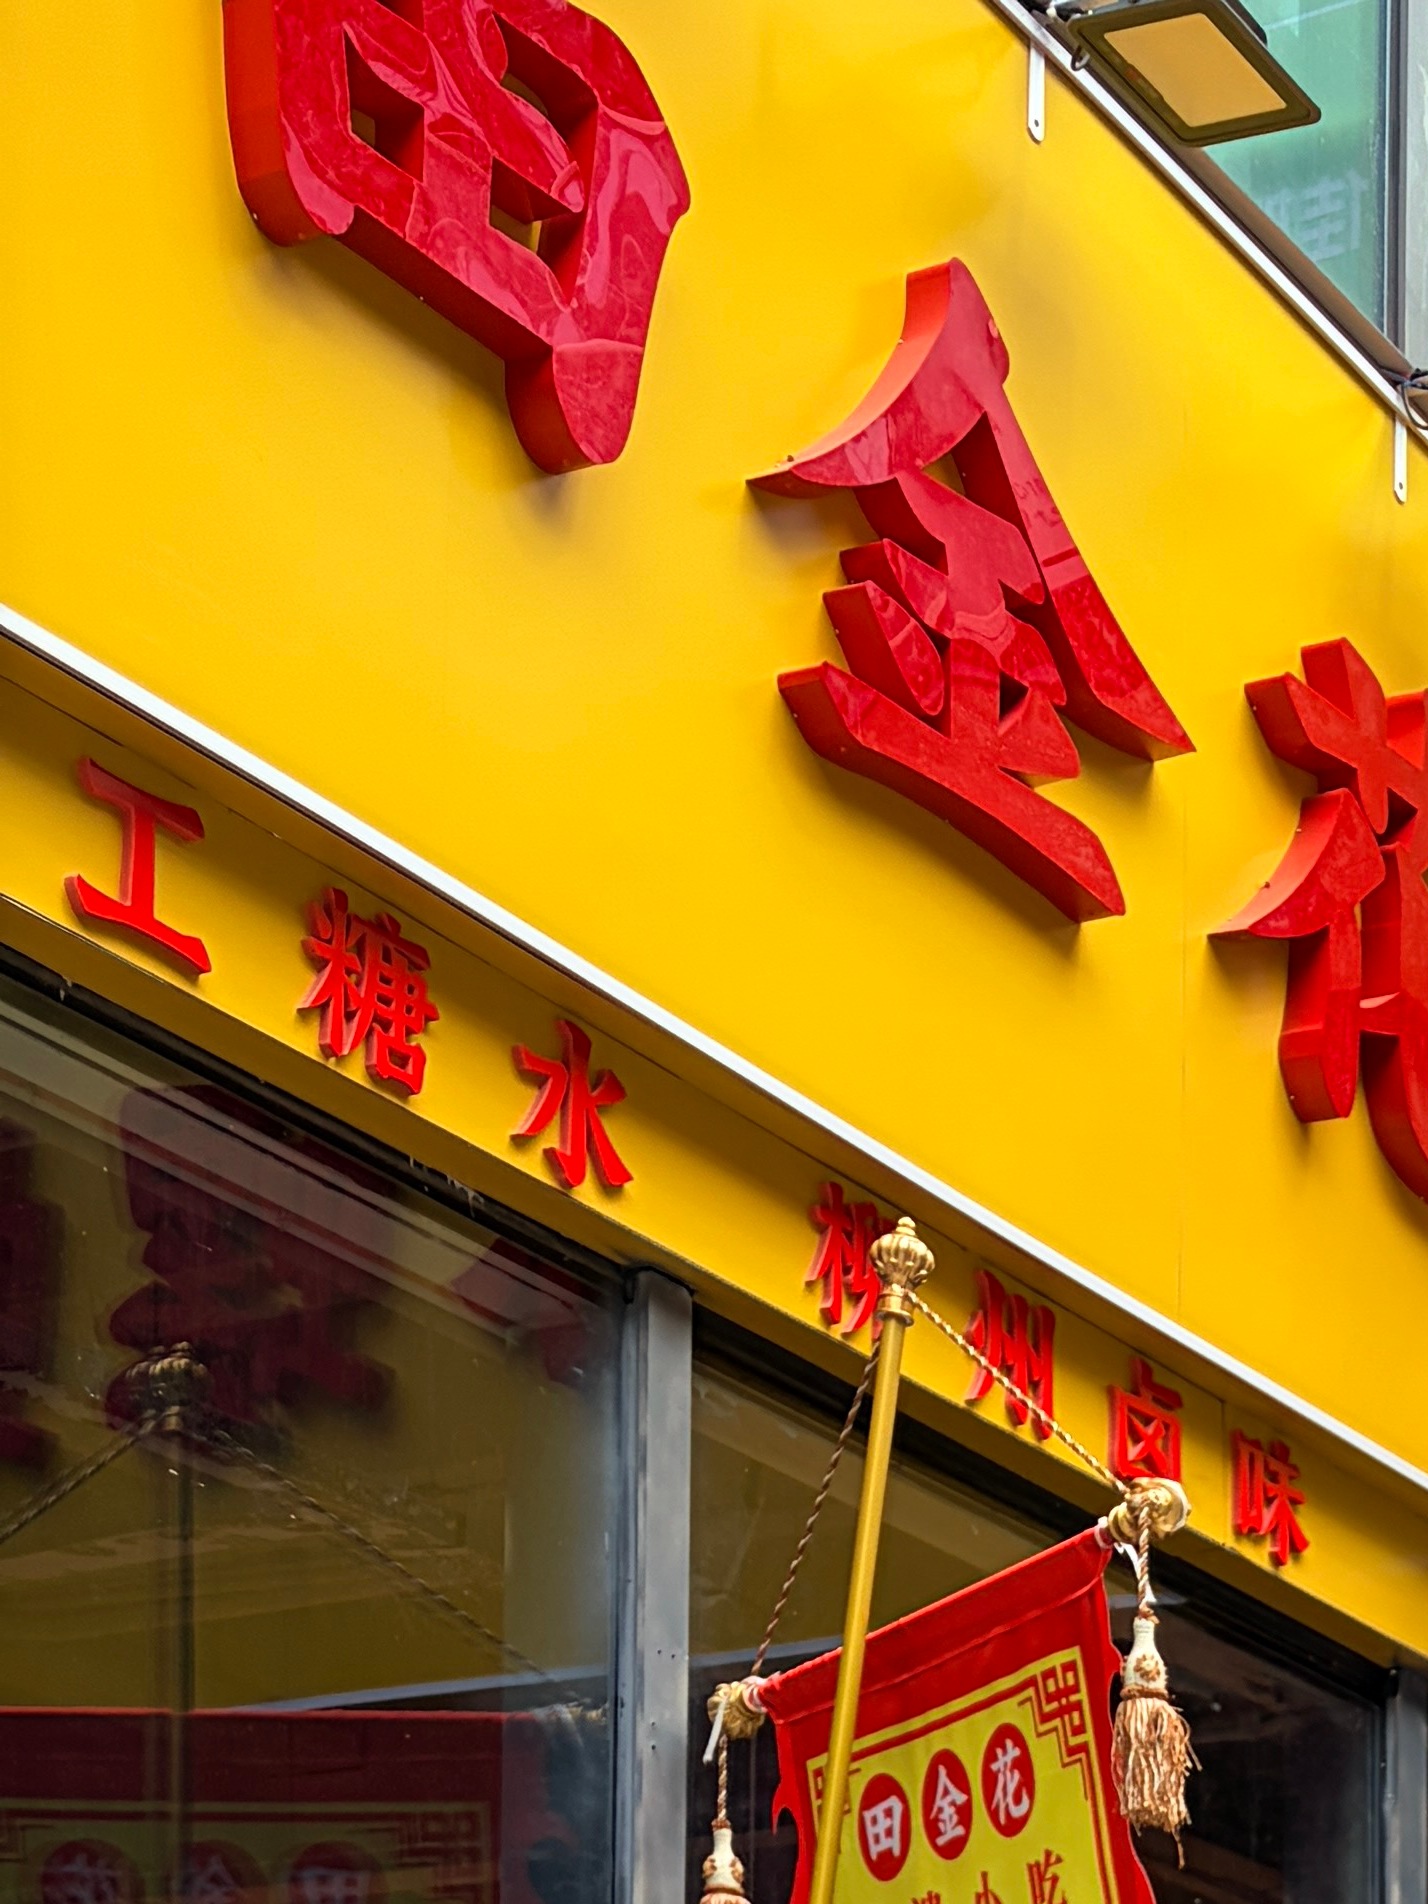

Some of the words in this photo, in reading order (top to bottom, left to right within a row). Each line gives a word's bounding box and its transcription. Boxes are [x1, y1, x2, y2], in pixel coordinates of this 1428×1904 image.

[65, 756, 634, 1188] 工糖水
[860, 1728, 1036, 1864] 田金花
